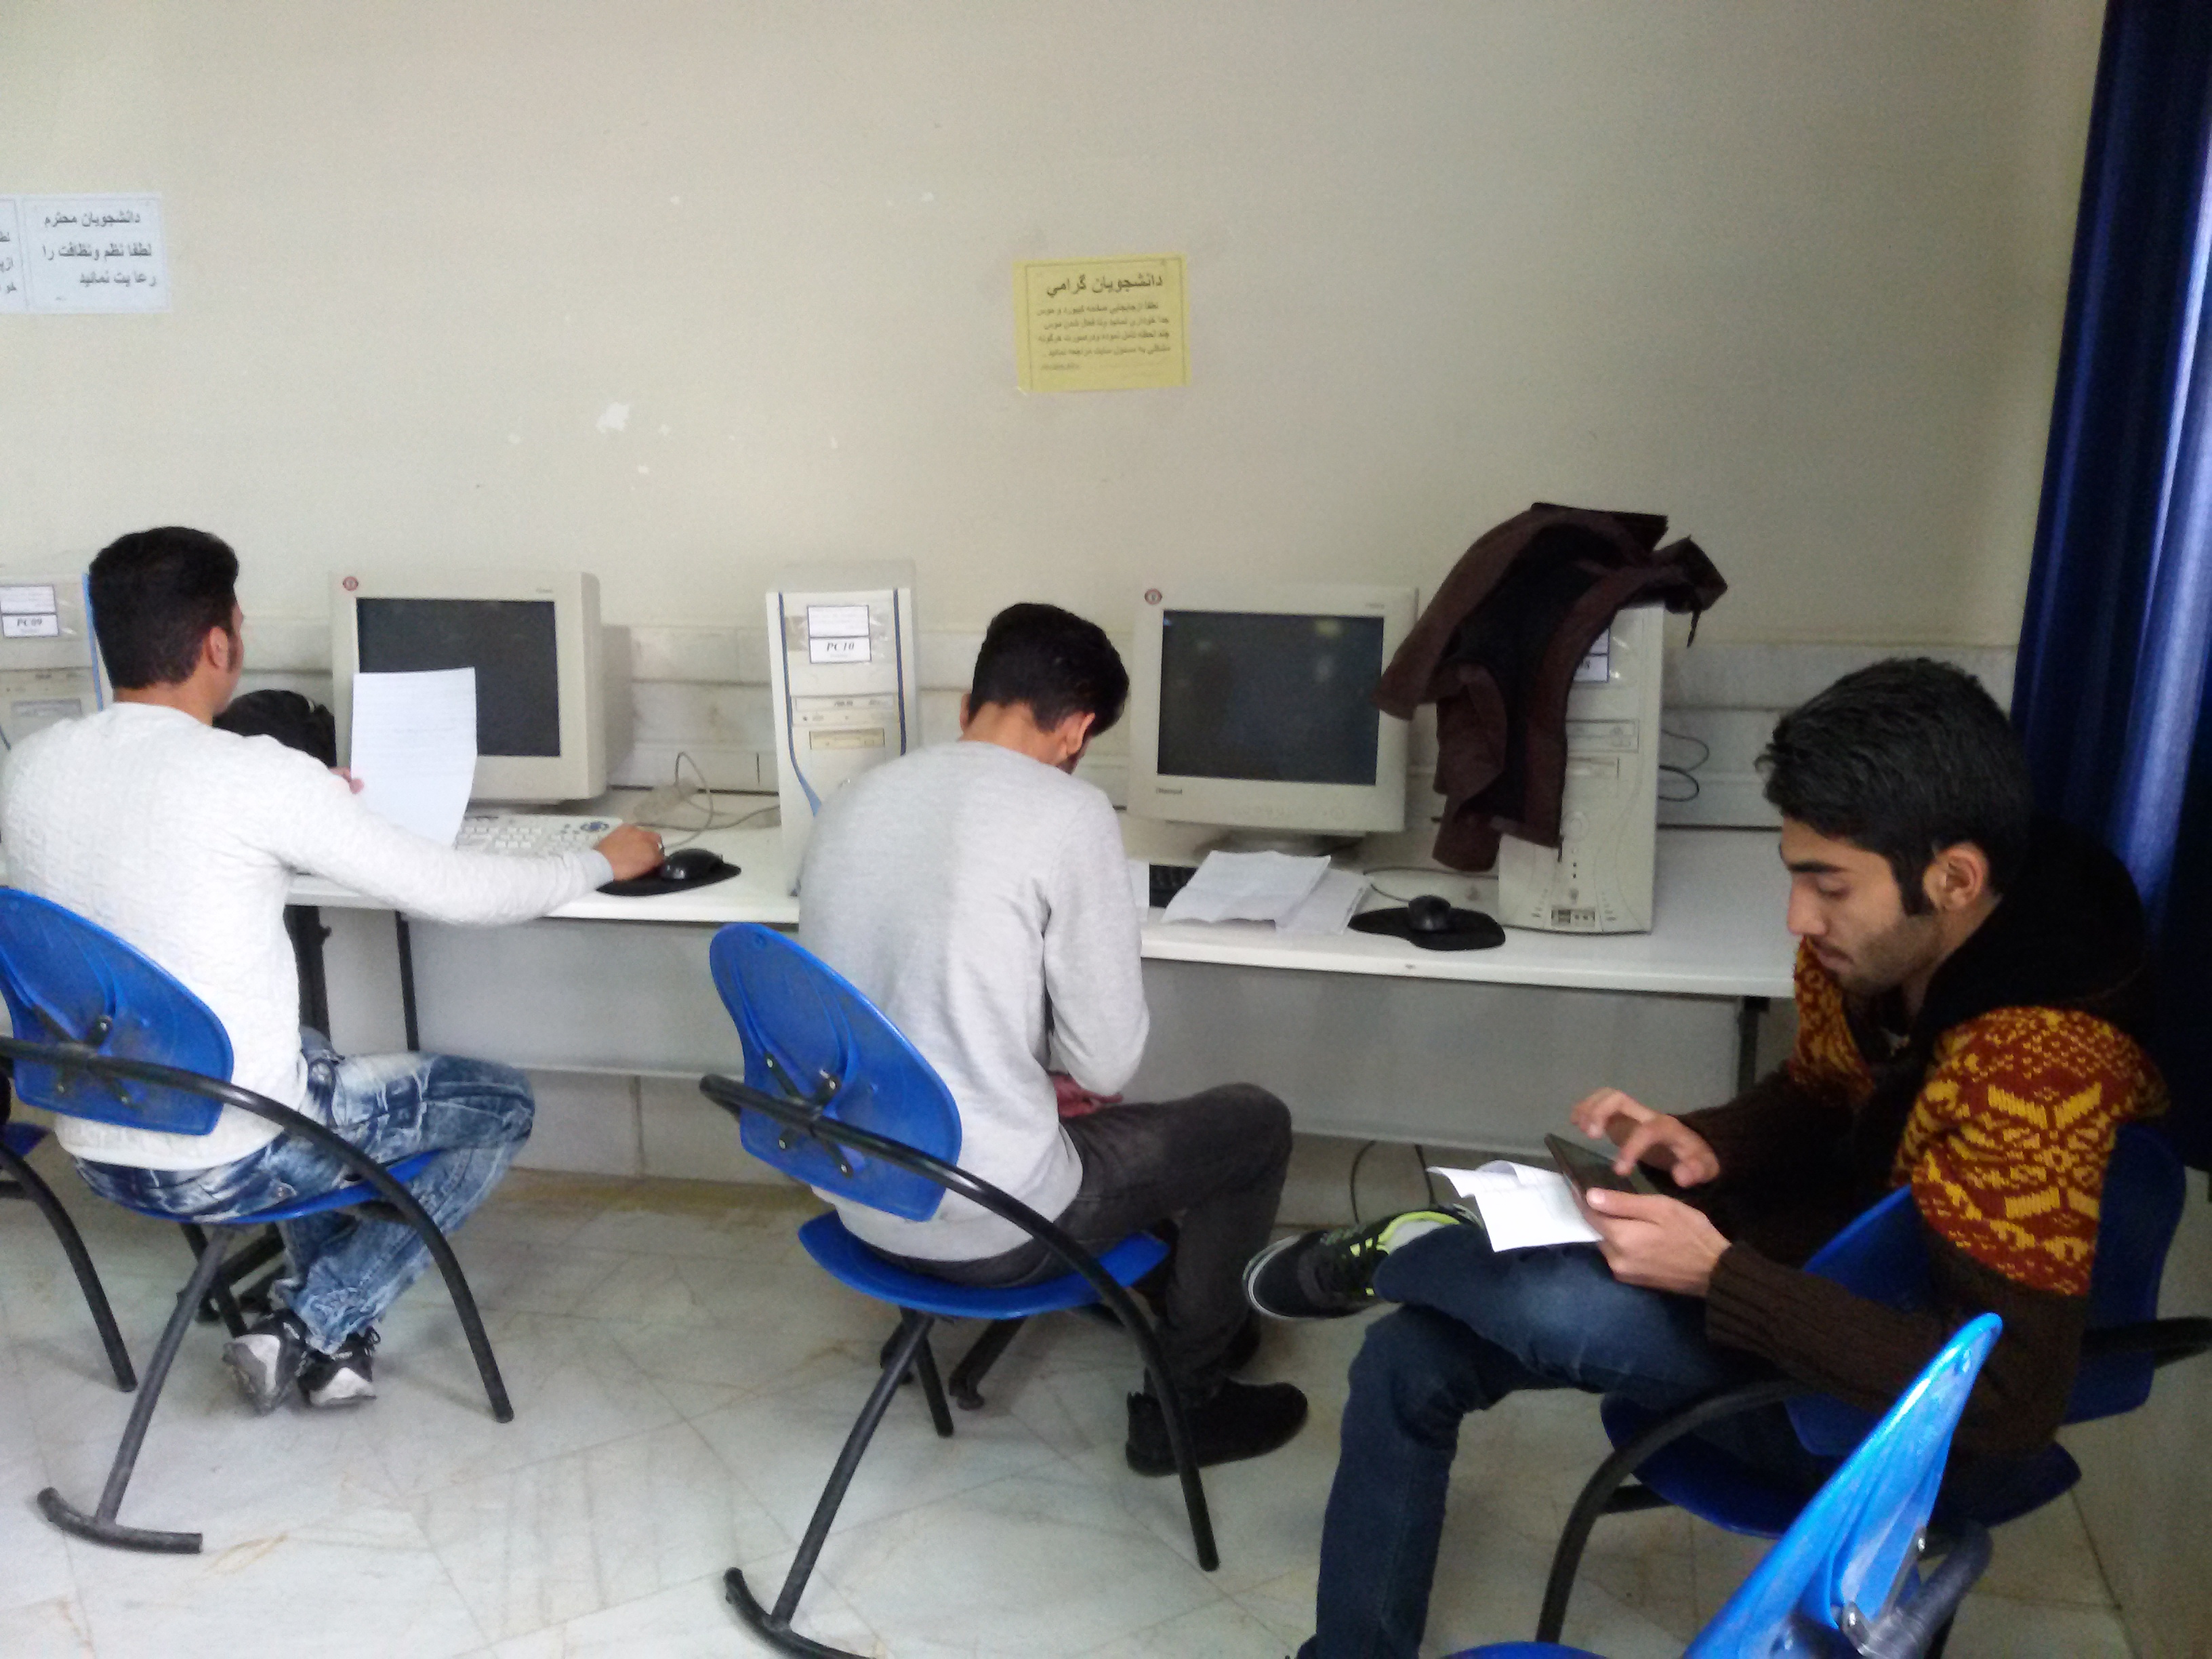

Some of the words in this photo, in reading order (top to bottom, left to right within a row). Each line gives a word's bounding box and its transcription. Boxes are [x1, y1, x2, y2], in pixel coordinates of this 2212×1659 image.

[44, 211, 77, 228] محترم
[81, 209, 141, 227] دانشجویان
[41, 244, 55, 261] را
[1092, 272, 1163, 293] دانشجویان
